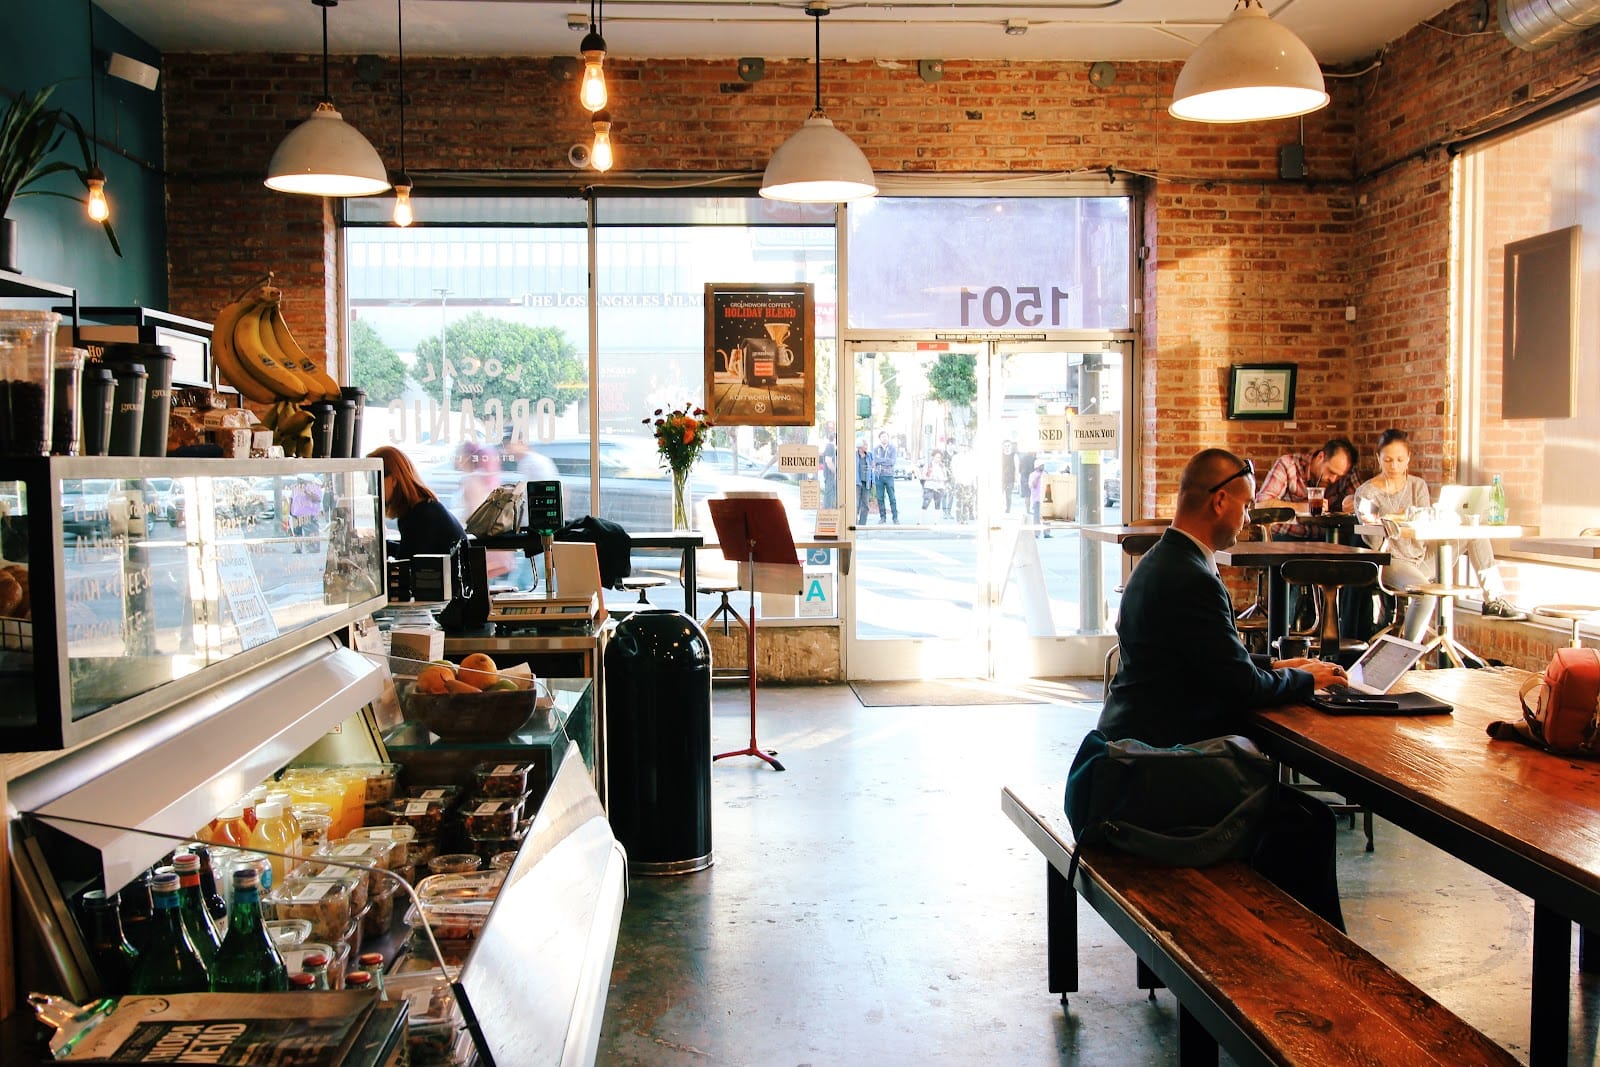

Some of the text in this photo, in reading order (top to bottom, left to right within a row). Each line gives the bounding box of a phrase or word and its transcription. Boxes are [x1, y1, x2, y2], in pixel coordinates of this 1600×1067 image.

[521, 292, 703, 307] THE LOS NGELES FILM
[724, 308, 796, 318] HOLIDAY BLEND
[1074, 428, 1115, 439] THANK YOU
[780, 456, 817, 468] BRUNCH
[805, 579, 826, 601] A
